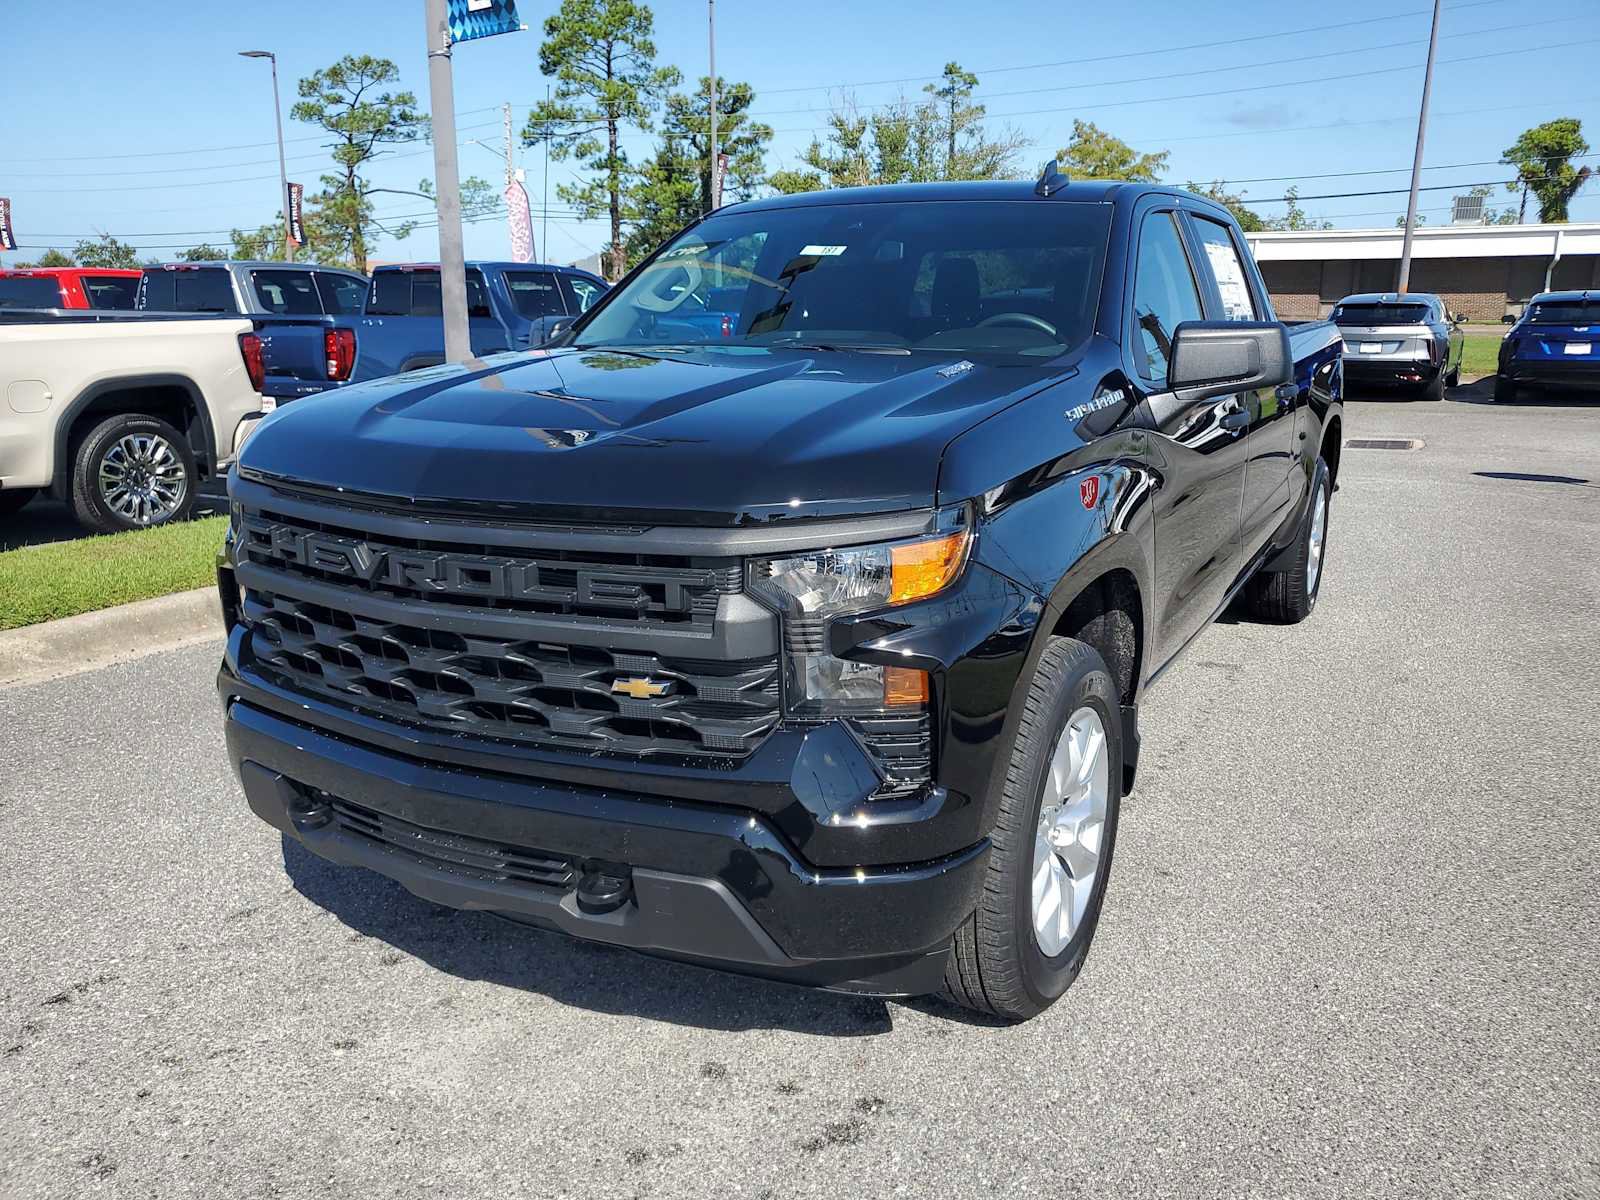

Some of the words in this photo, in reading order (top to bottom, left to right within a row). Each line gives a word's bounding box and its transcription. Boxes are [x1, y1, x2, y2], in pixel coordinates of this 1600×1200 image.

[291, 186, 299, 220] TRUCKS
[293, 221, 302, 242] NEW
[247, 524, 716, 612] CHEVROLET
